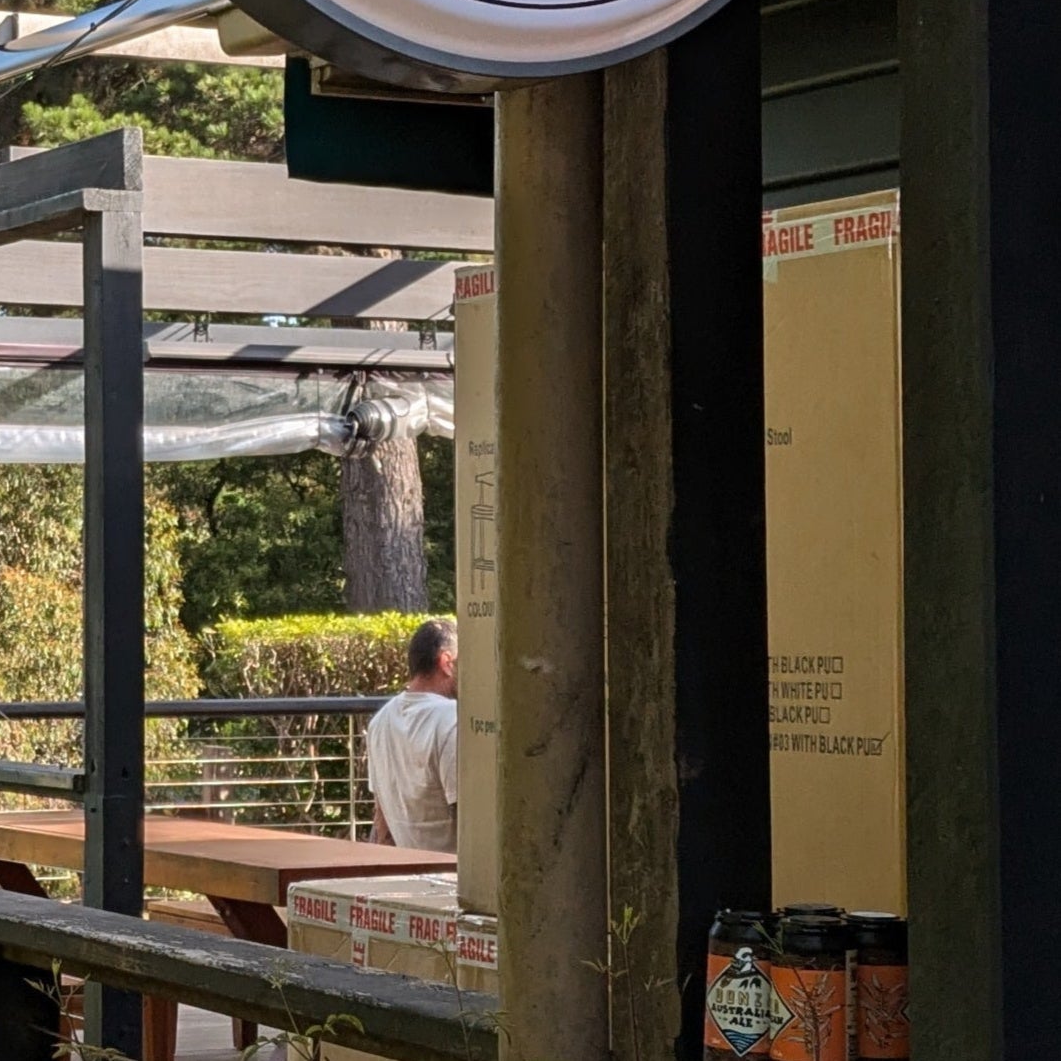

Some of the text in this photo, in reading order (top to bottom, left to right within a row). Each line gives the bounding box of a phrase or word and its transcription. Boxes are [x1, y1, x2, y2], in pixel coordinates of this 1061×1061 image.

[761, 223, 814, 257] AGILE
[766, 427, 793, 445] Stool
[781, 656, 816, 674] BLACK
[816, 656, 833, 674] PU
[782, 682, 813, 700] WHITE
[814, 682, 829, 700] PU
[769, 706, 820, 724] BLACK PU
[791, 734, 817, 752] WITH
[819, 736, 857, 754] BLACK
[857, 737, 871, 756] PU
[293, 895, 337, 923] FRAGILE
[349, 905, 396, 934] FRAGILE
[729, 1017, 753, 1027] ALE
